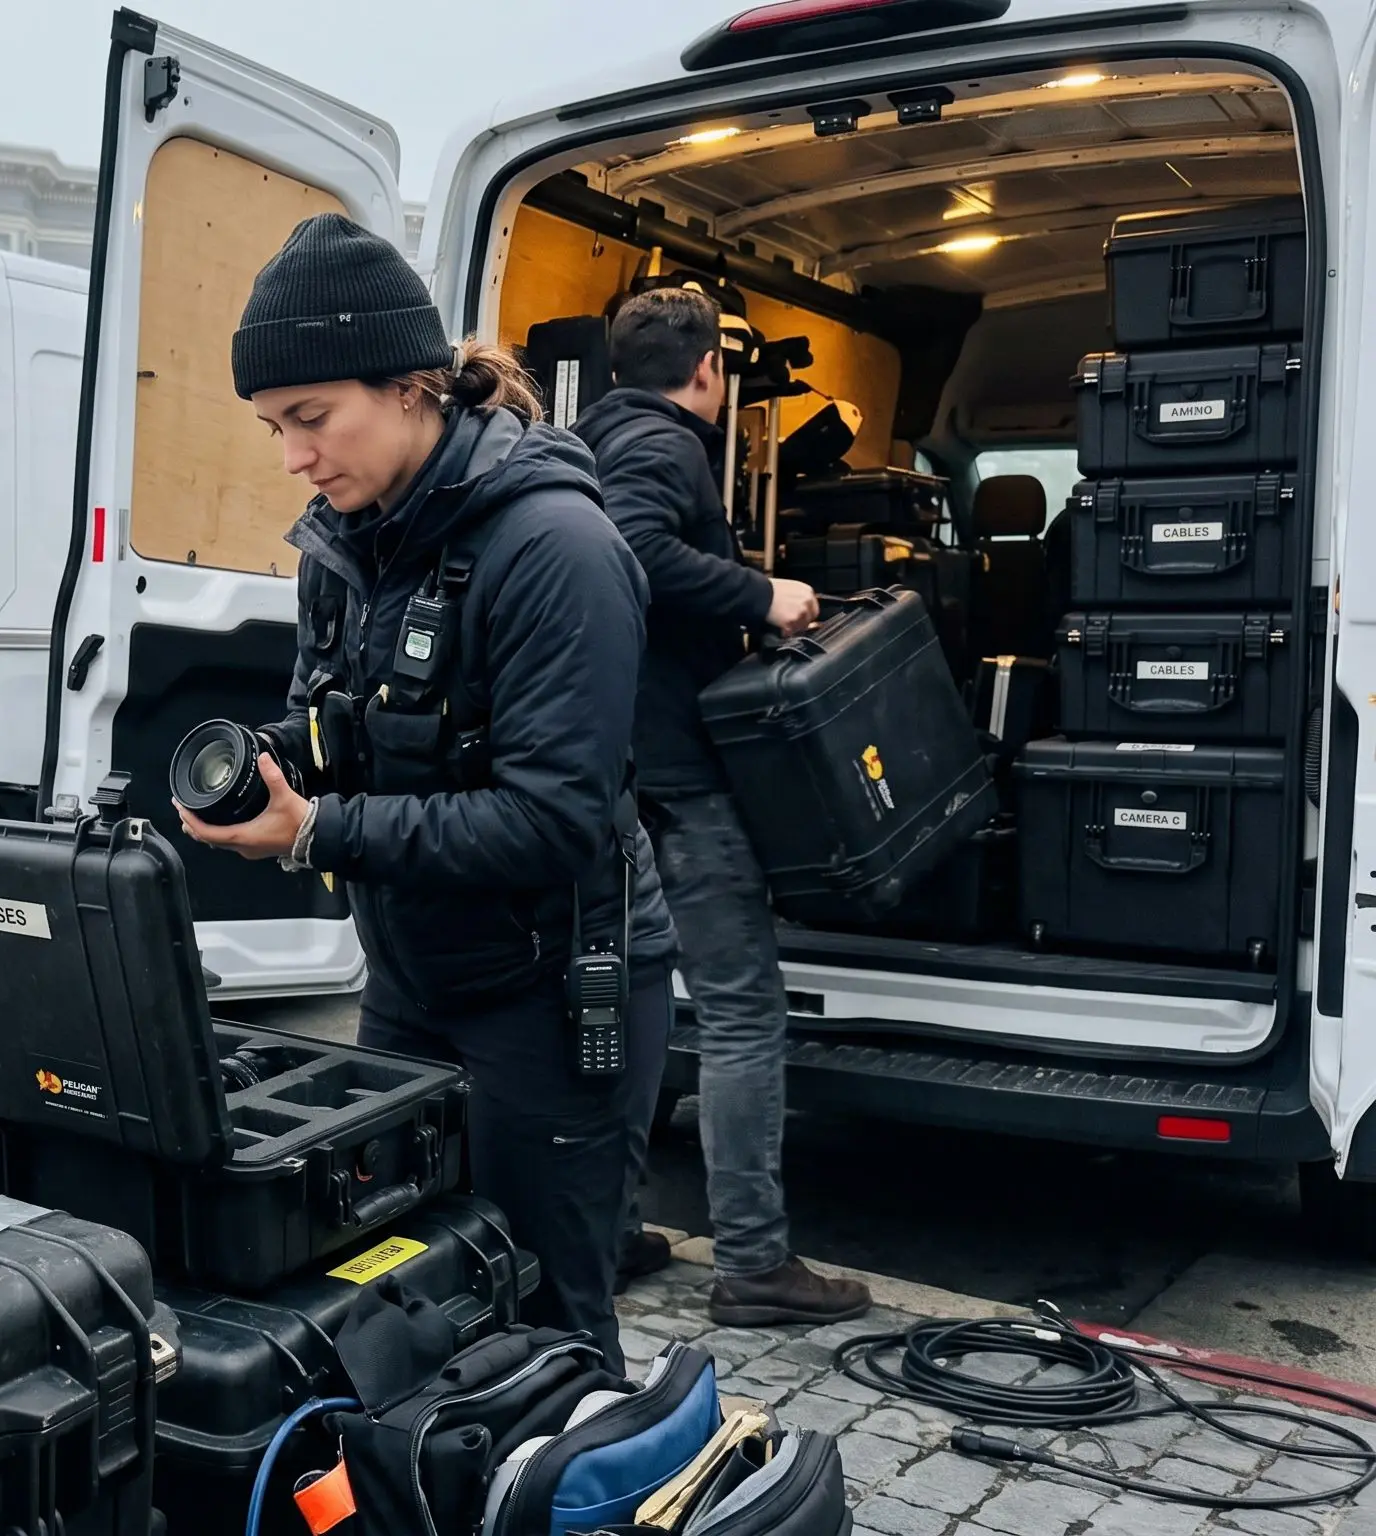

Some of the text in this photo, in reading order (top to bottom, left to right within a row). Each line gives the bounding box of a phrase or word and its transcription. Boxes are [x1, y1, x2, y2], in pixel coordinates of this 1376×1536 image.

[1163, 526, 1209, 538] CABLES
[1150, 665, 1195, 675] CABLES
[1120, 812, 1180, 825] CAMERA C
[62, 1079, 99, 1095] PELICAN
